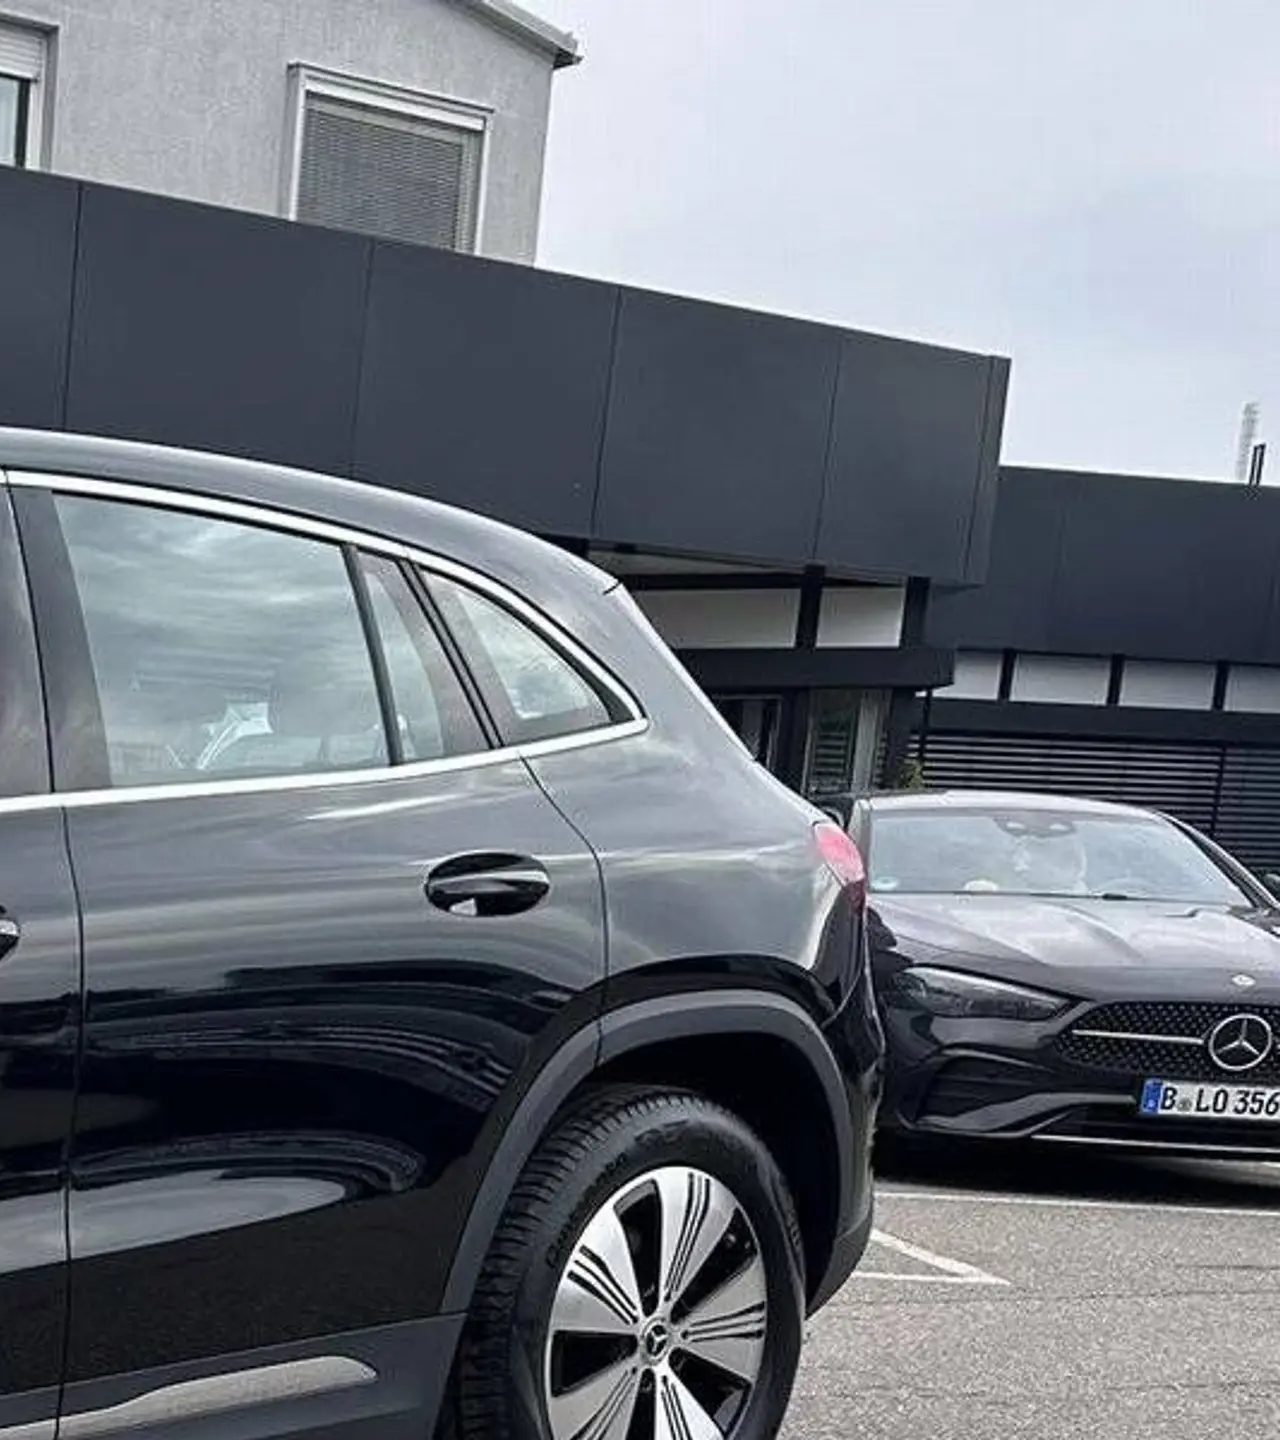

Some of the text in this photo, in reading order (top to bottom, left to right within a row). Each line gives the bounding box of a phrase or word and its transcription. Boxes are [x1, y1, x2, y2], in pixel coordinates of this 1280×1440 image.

[1160, 1086, 1280, 1115] B LO 356
